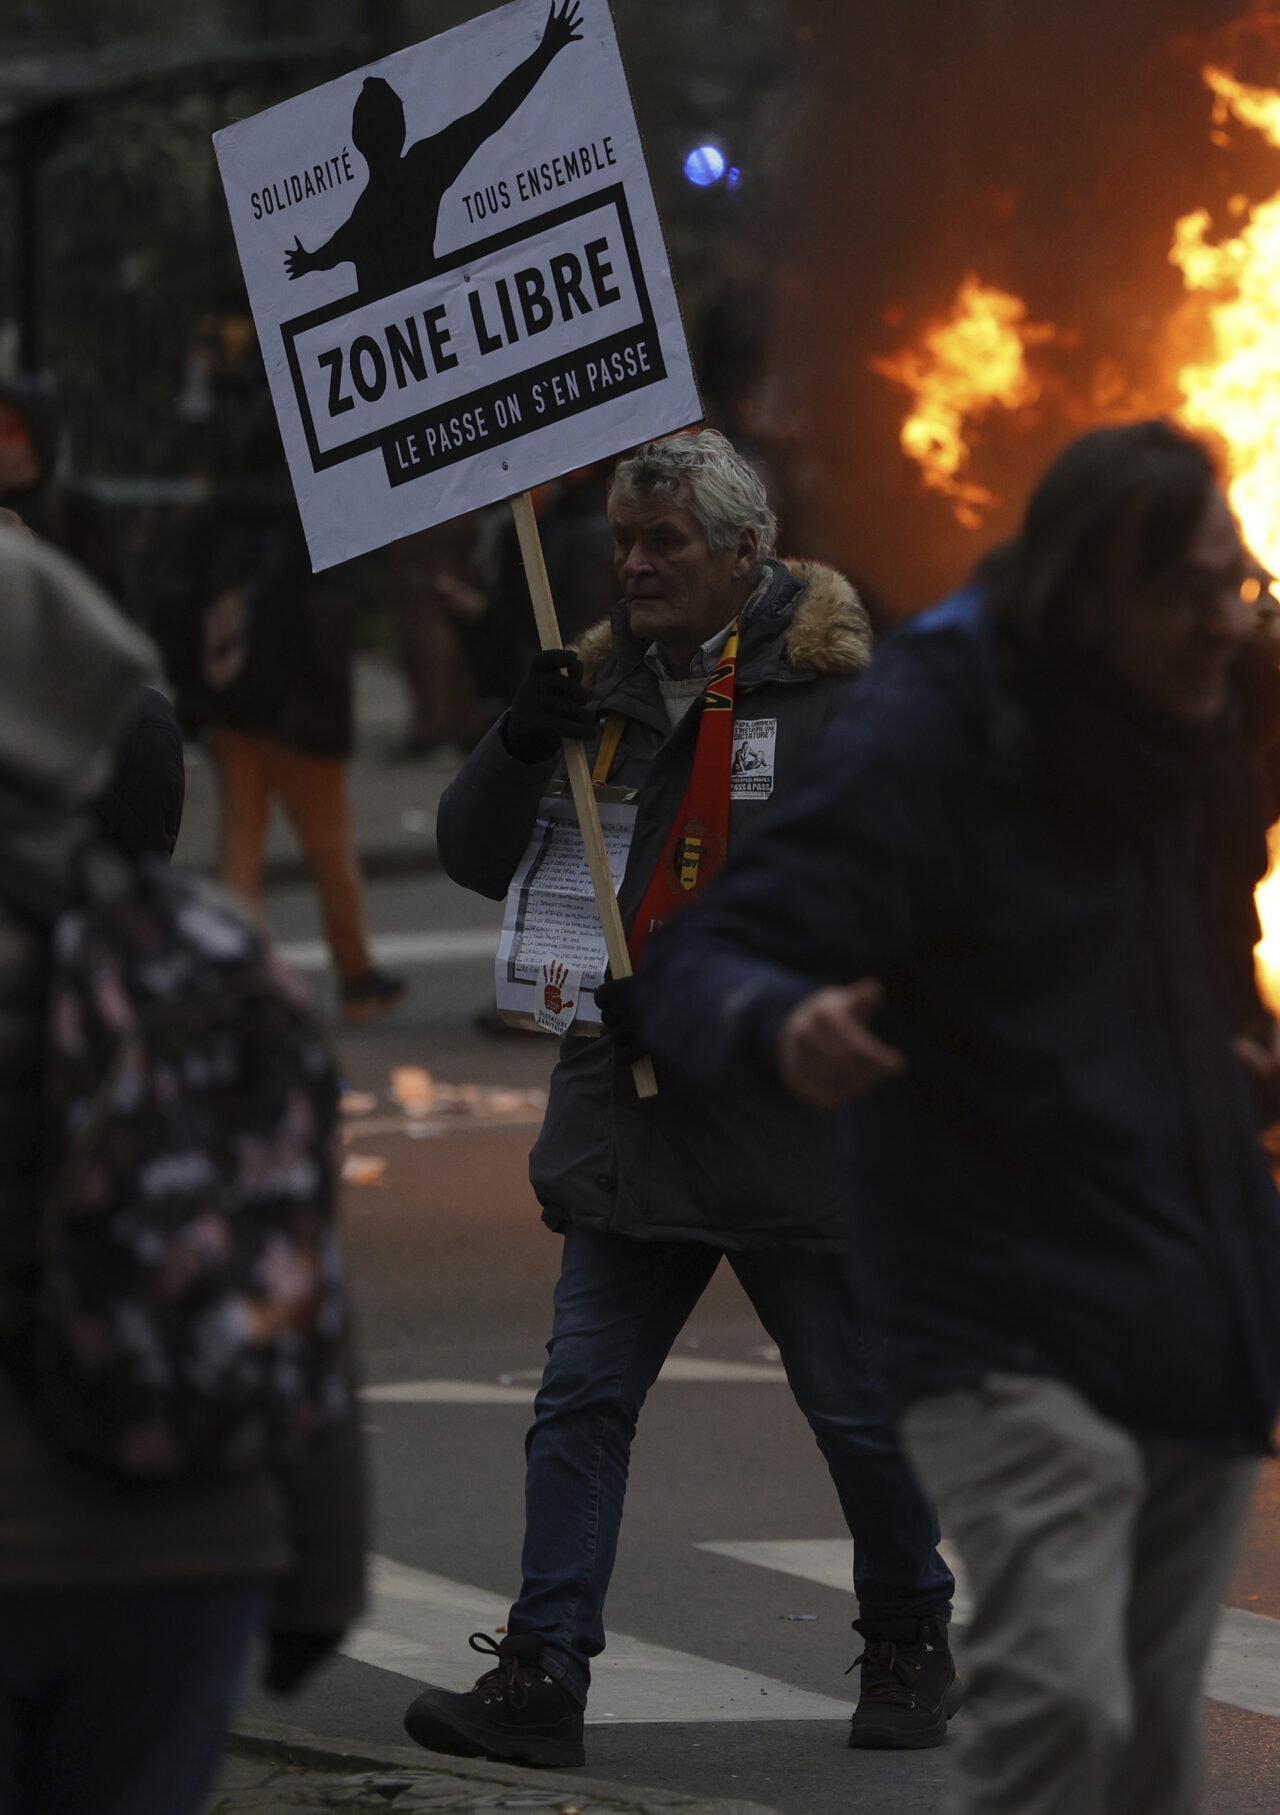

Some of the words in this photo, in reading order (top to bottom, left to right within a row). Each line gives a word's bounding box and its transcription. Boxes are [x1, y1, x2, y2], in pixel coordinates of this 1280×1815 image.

[251, 147, 354, 220] SOLIDARITÉ
[462, 181, 511, 223] TOUS
[516, 137, 616, 202] ENSEMBLE
[318, 304, 459, 417] ZONE
[468, 237, 621, 356] LIBRE
[396, 435, 419, 468] LE
[426, 408, 489, 456] PASSE
[495, 394, 522, 427] ON
[587, 342, 651, 391] PASSE
[734, 731, 769, 741] DICTATURE
[539, 1010, 568, 1028] DICTATURE
